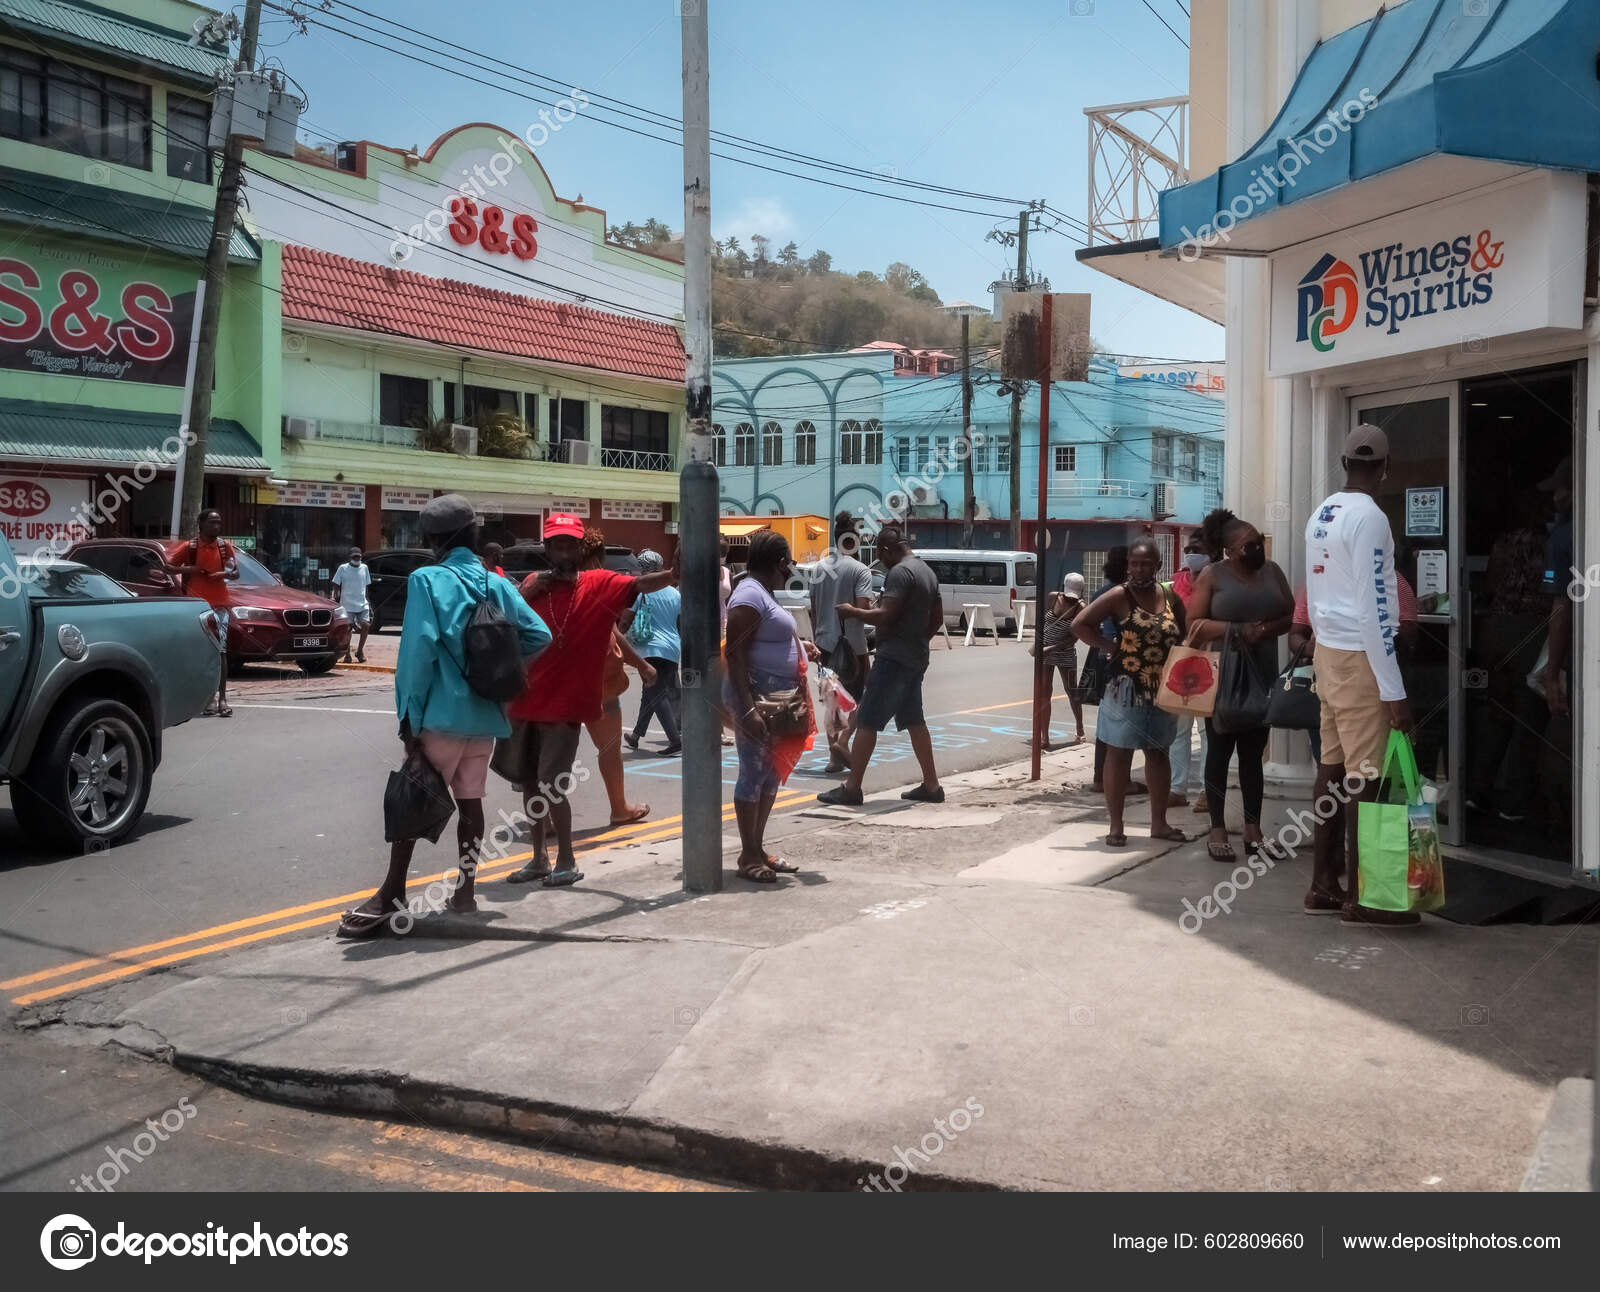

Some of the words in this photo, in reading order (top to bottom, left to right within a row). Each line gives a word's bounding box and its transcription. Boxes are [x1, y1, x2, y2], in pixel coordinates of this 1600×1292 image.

[449, 197, 539, 261] S&S
[0, 257, 174, 361] S&S
[1365, 266, 1493, 335] Spirits
[0, 487, 46, 510] S&S
[1374, 548, 1394, 656] INDIANA
